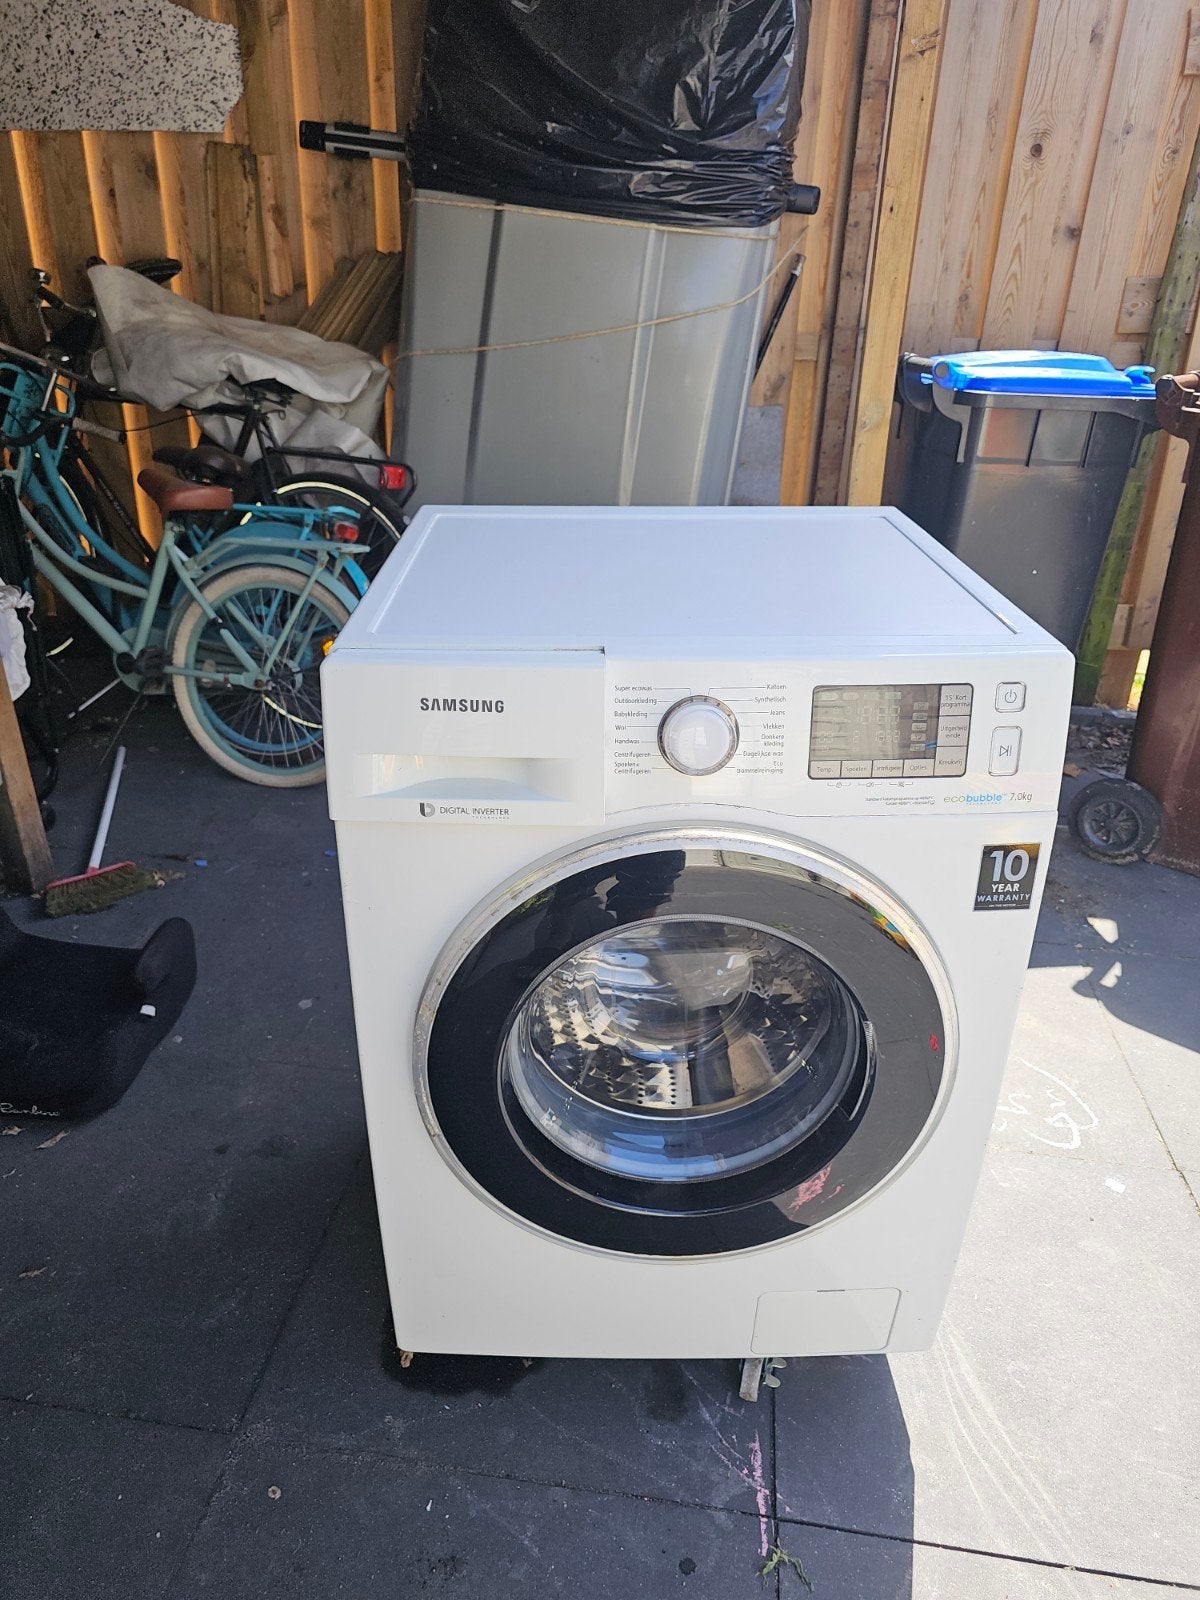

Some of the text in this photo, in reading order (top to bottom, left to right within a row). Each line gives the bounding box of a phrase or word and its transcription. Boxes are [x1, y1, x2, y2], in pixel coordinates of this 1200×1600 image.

[614, 697, 658, 705] Outdoorkleding
[754, 696, 787, 704] Synthetisch
[420, 698, 505, 713] SAMSUNG
[614, 710, 648, 718] Babykleding
[909, 764, 927, 772] Opties
[1009, 792, 1033, 802] 7.0kg
[439, 806, 469, 815] DIGITAL
[989, 849, 1030, 882] 10
[991, 883, 1020, 893] YEAR
[976, 893, 1031, 902] WARRANTY
